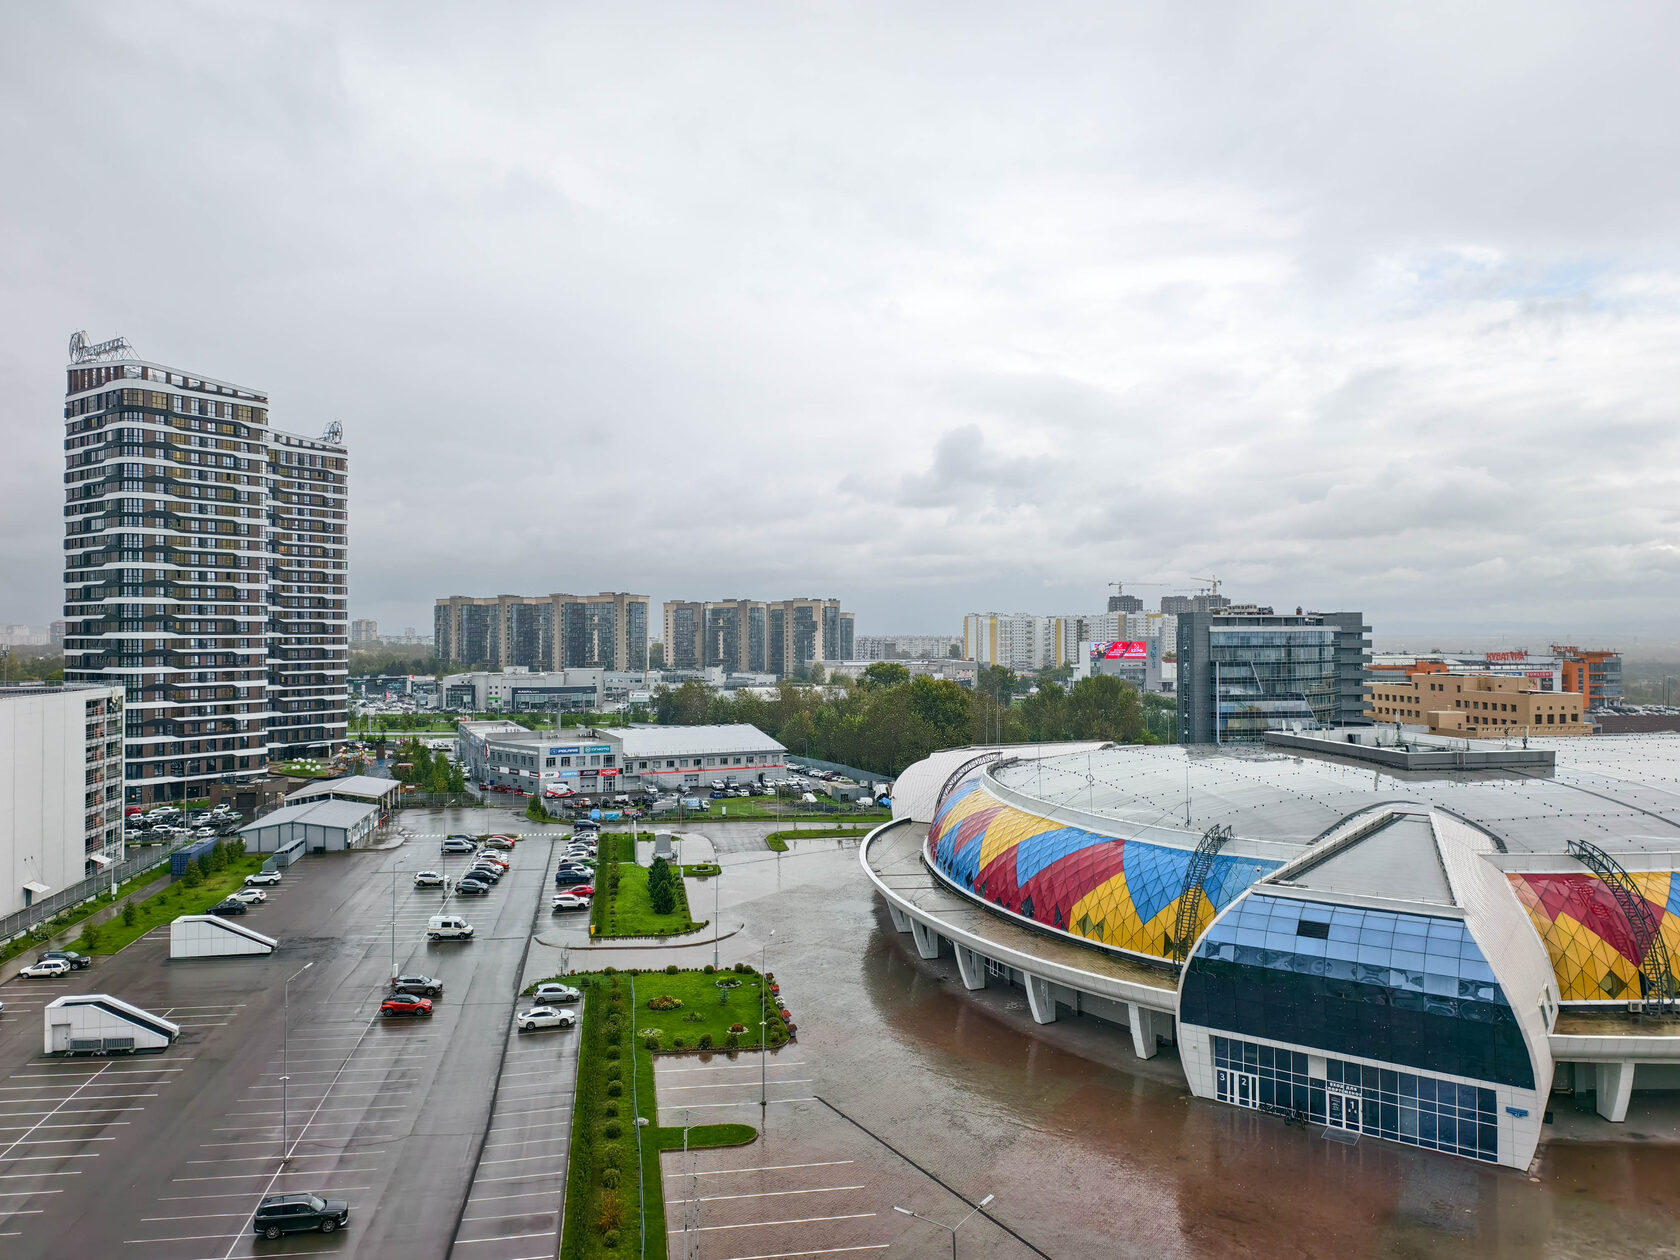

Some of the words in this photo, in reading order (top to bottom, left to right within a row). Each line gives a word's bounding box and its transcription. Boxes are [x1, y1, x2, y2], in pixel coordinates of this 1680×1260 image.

[1219, 1073, 1225, 1081] 3
[1241, 1078, 1247, 1086] 2
[1349, 1101, 1355, 1109] 1
